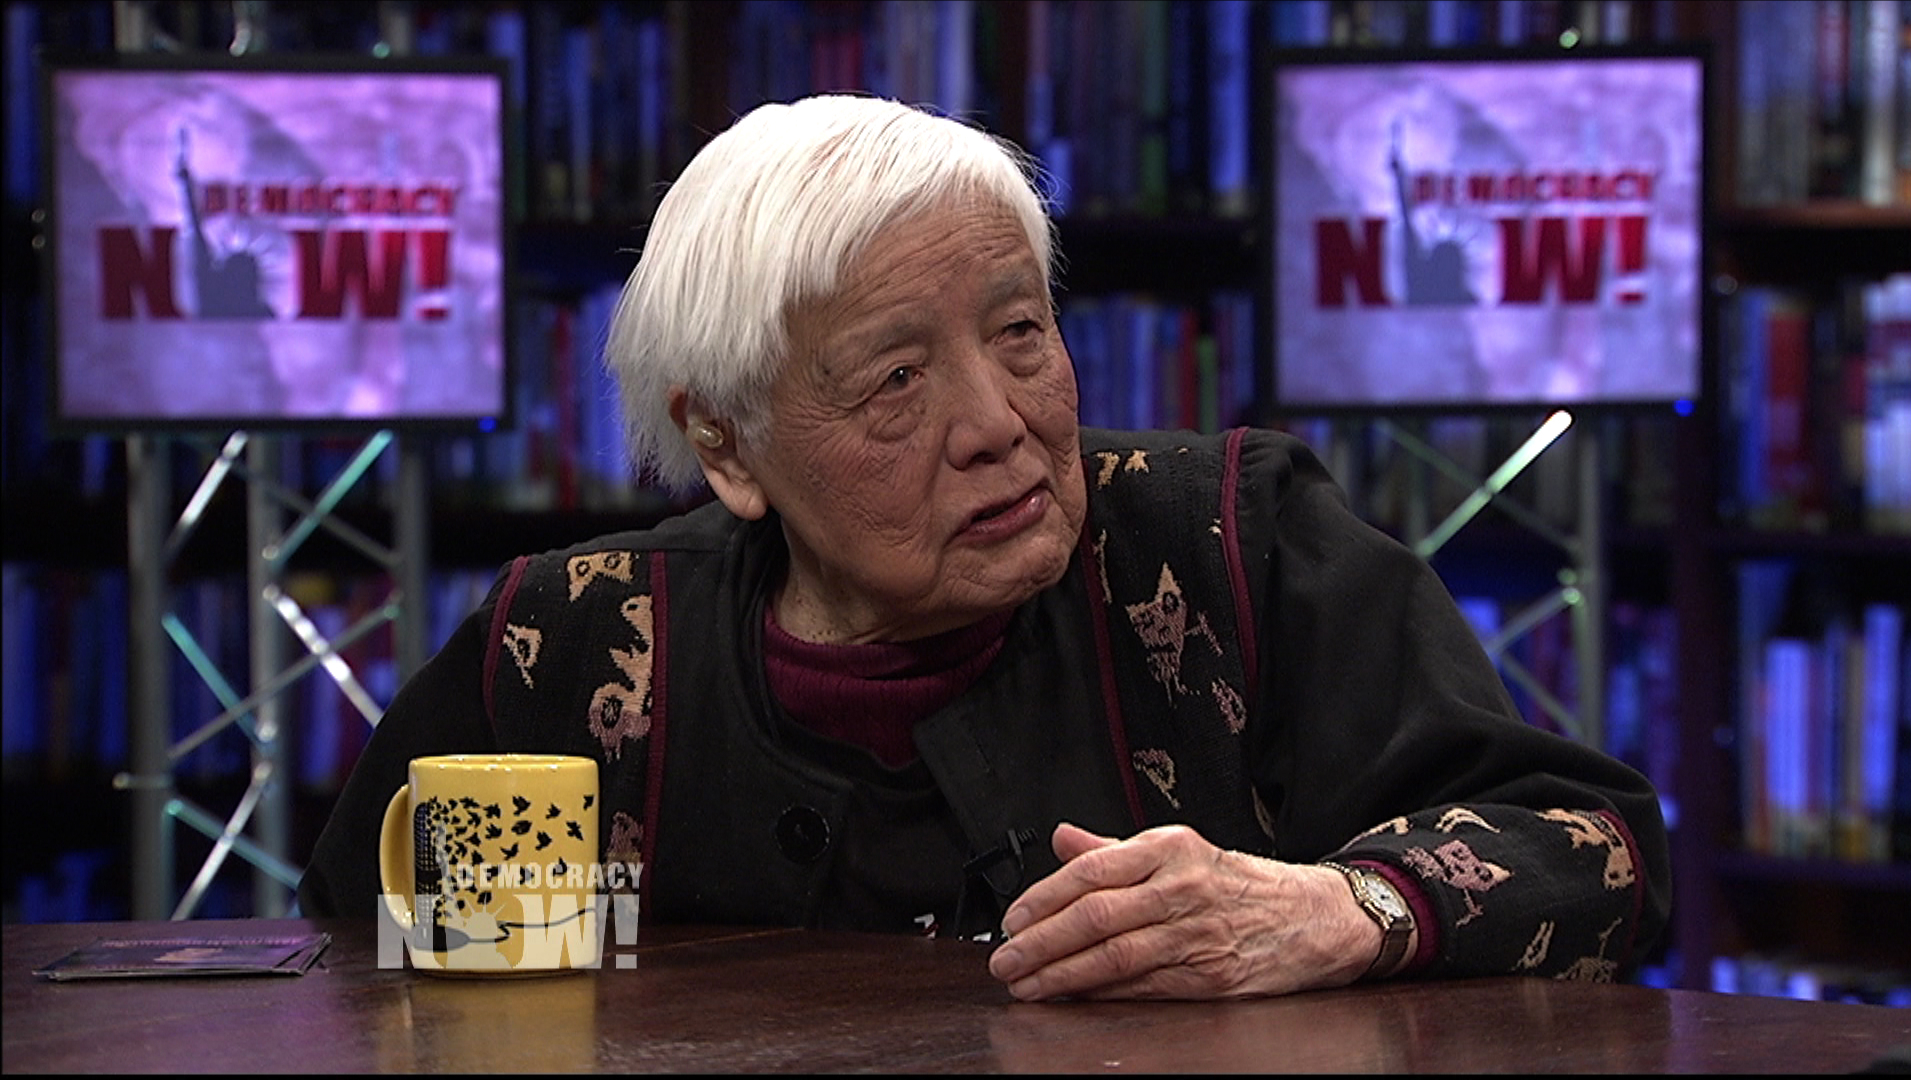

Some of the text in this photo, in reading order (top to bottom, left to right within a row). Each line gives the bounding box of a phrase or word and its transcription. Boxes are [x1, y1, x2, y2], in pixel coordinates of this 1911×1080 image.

[204, 182, 458, 217] DEMOCRACY
[1414, 171, 1659, 205] DEMOCRACY
[99, 226, 449, 319] NOW!
[1315, 216, 1647, 306] NOW!
